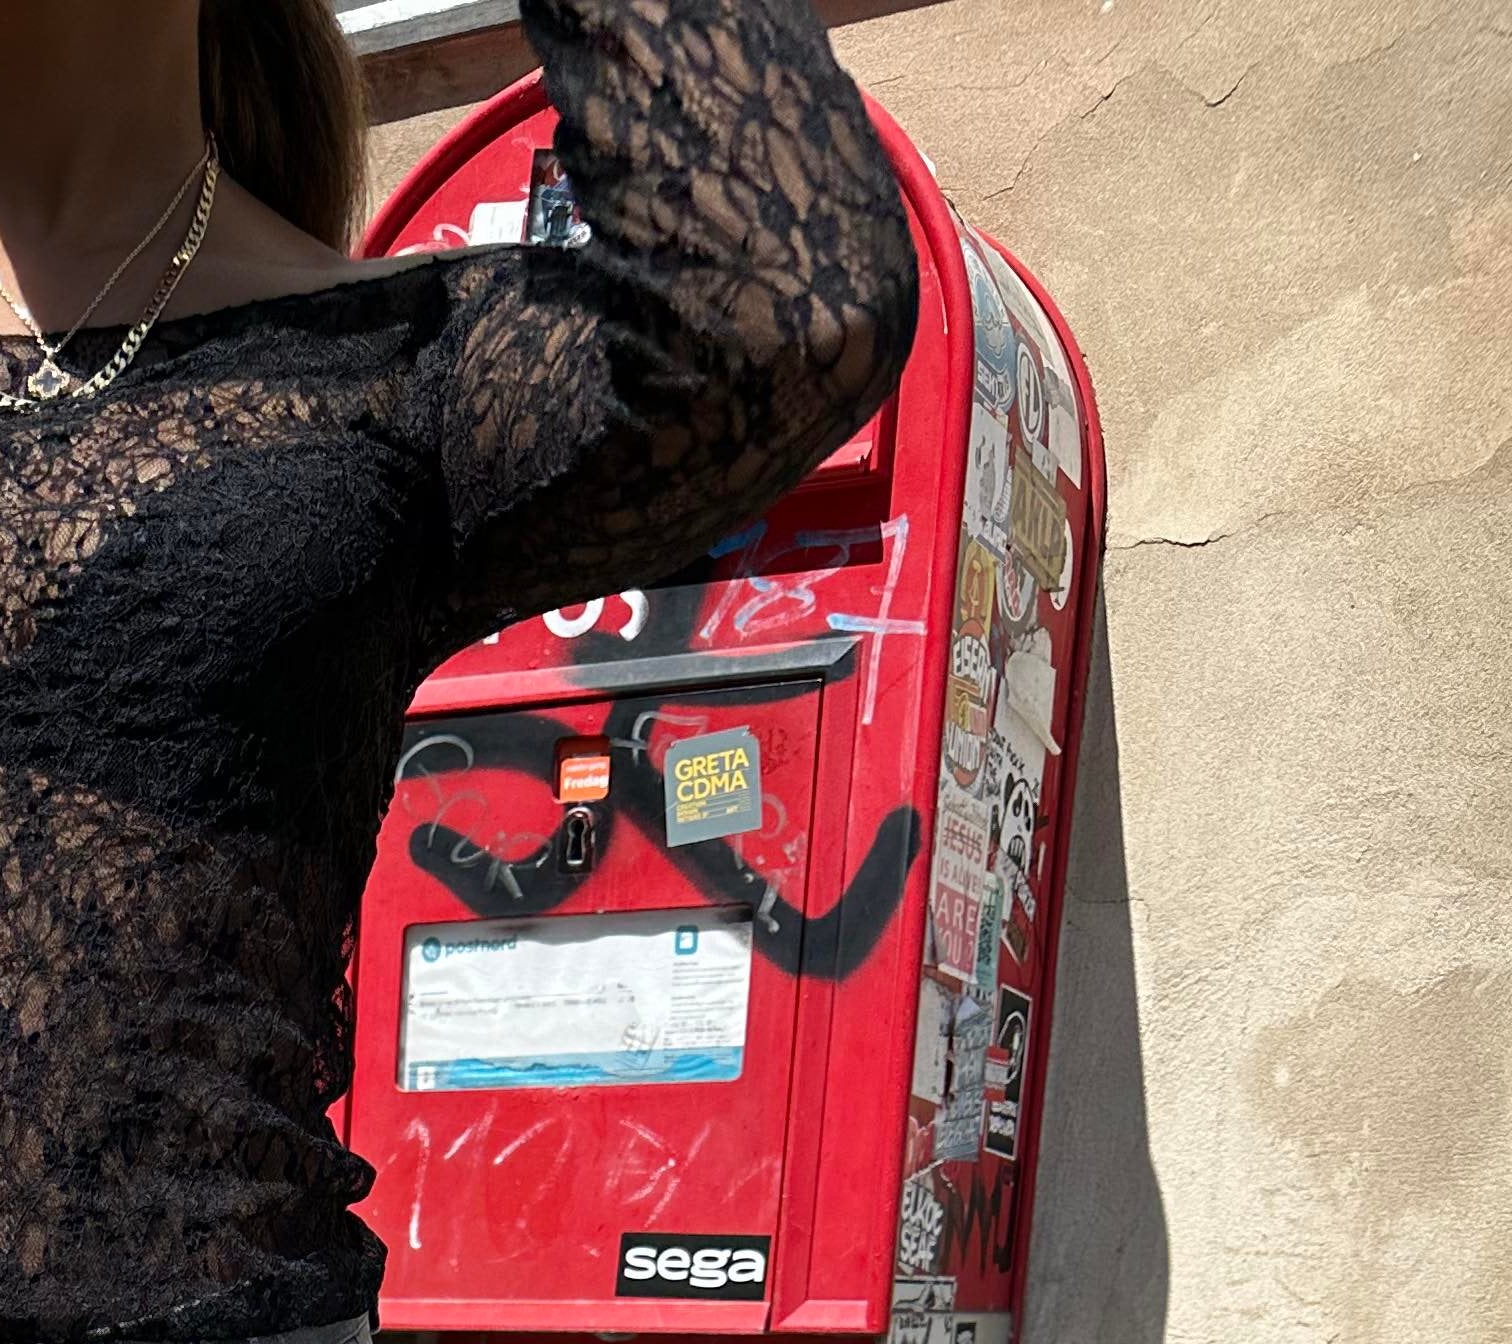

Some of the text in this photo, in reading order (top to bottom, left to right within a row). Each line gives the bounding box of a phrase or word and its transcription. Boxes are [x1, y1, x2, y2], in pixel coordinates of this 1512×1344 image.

[675, 747, 749, 781] GRETA
[935, 890, 979, 937] ARE
[445, 934, 518, 957] postnord
[623, 1246, 766, 1289] sega
